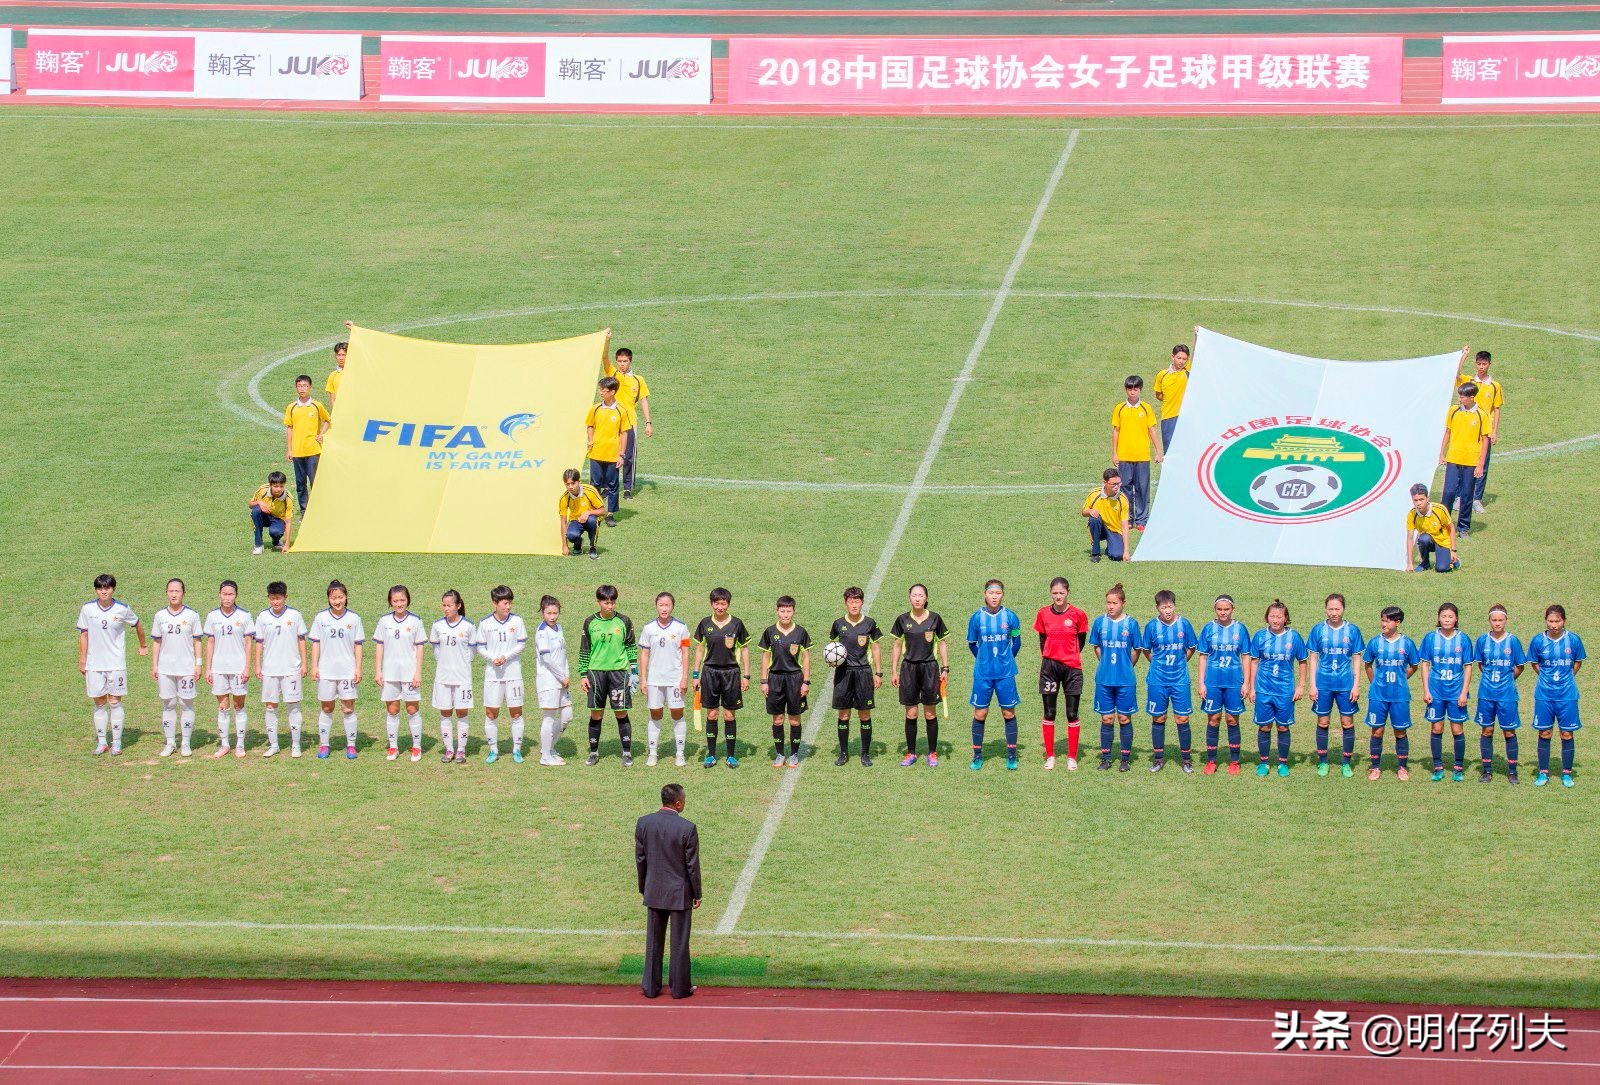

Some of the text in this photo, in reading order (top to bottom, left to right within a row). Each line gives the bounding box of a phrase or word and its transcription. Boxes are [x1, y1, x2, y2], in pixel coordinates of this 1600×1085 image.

[35, 50, 84, 73] 鞠客
[208, 53, 255, 76] 鞠客
[388, 57, 435, 80] 鞠客
[559, 58, 606, 80] 鞠客
[759, 54, 1370, 90] 2018中国足球协会女子足球甲级联赛
[1451, 57, 1501, 80] 鞠客
[363, 419, 486, 448] FIFA
[1221, 415, 1392, 447] 中国足球协会
[429, 451, 523, 460] MY GAME
[426, 459, 545, 470] IS FAIR PLAY
[1281, 483, 1308, 497] CFA
[102, 619, 107, 630] 2
[168, 624, 181, 635] 25
[221, 625, 233, 635] 12
[276, 626, 281, 635] 7
[331, 628, 344, 639] 26
[394, 629, 400, 639] 8
[498, 632, 506, 642] 11
[660, 637, 666, 647] 6
[992, 646, 998, 657] 9
[1111, 652, 1116, 664] 3
[1165, 654, 1176, 666] 17
[1219, 656, 1232, 668] 27
[1385, 671, 1396, 683] 10
[1440, 670, 1453, 680] 20
[1491, 671, 1500, 682] 15
[118, 676, 124, 686] 2
[181, 679, 194, 689] 25
[291, 680, 297, 690] 7
[1044, 681, 1058, 692] 32
[513, 686, 522, 697] 11
[611, 689, 624, 701] 27
[673, 687, 680, 698] 6
